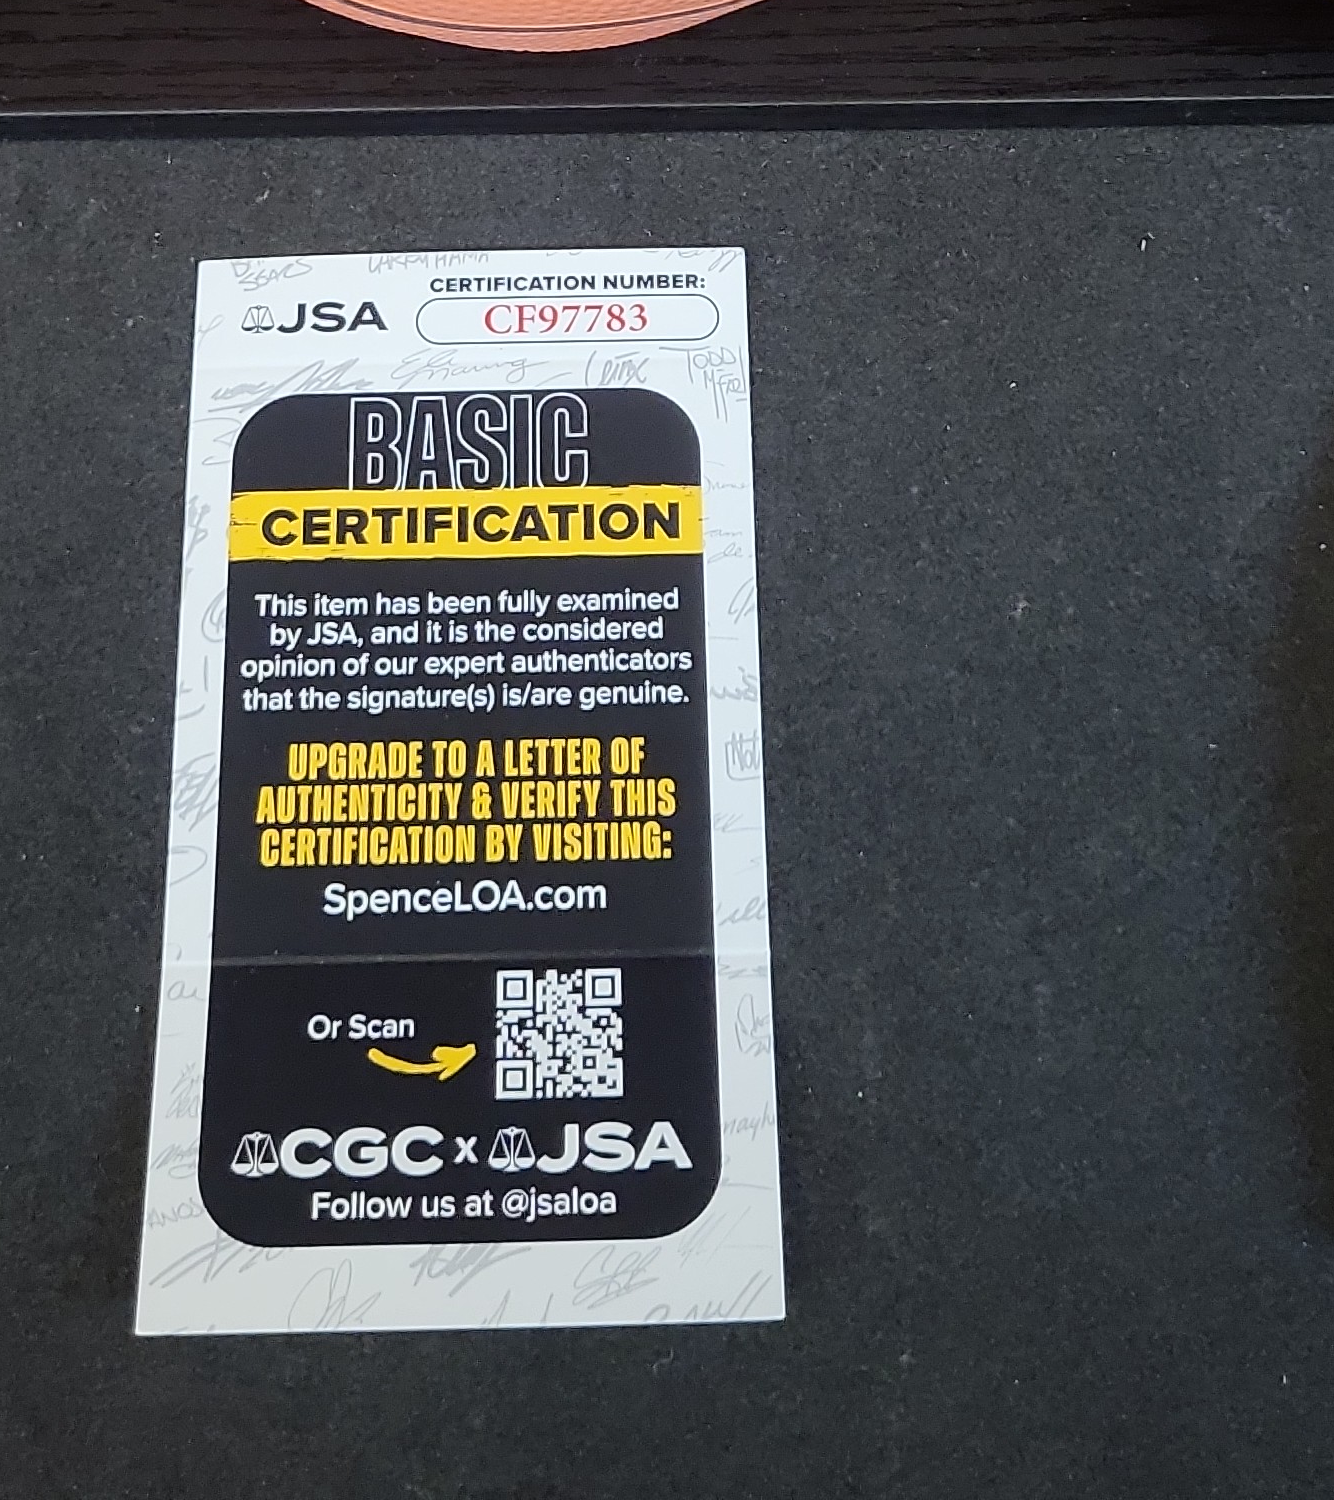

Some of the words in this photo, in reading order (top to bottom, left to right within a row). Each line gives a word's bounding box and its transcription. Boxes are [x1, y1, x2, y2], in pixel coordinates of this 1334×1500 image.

[429, 275, 597, 293] CERTIFICATION
[603, 274, 706, 291] NUMBER:
[277, 301, 389, 334] JSA
[484, 303, 648, 335] CF97783
[348, 392, 589, 492] BASIC
[265, 502, 680, 546] CERTIFICATION
[254, 593, 308, 617] This
[313, 592, 369, 617] item
[375, 591, 421, 617] has
[427, 591, 492, 615] been
[497, 588, 552, 618] fully
[556, 586, 679, 613] examined
[269, 622, 303, 652] by
[306, 621, 364, 649] JSA,
[370, 619, 419, 645] and
[473, 618, 517, 643] the
[522, 615, 664, 642] considered
[239, 652, 336, 684] opinion
[342, 652, 371, 677] of
[373, 656, 419, 676] our
[423, 651, 506, 681] expert
[510, 647, 693, 674] authenticators
[242, 686, 294, 712] that
[298, 686, 342, 711] the
[346, 682, 496, 715] signature(s)
[502, 681, 573, 707] is/are
[578, 679, 690, 711] genuine.
[287, 740, 424, 782] UPGRADE
[431, 739, 467, 779] TO
[504, 737, 602, 777] LETTER
[610, 736, 645, 775] OF
[255, 782, 463, 825] AUTHENTICITY
[500, 779, 602, 820] VERIFY
[609, 777, 677, 817] THIS
[260, 824, 476, 868] CERTIFICATION
[485, 823, 524, 863] BY
[532, 820, 672, 862] VISITING:
[322, 879, 607, 922] SpenceLOA.com
[307, 1014, 343, 1041] Or
[348, 1013, 415, 1040] Scan
[278, 1126, 444, 1179] CGC
[536, 1122, 694, 1173] JSA
[310, 1190, 413, 1221] Follow
[421, 1195, 456, 1219] us
[464, 1189, 495, 1218] at
[501, 1185, 617, 1223] @jsaloa
